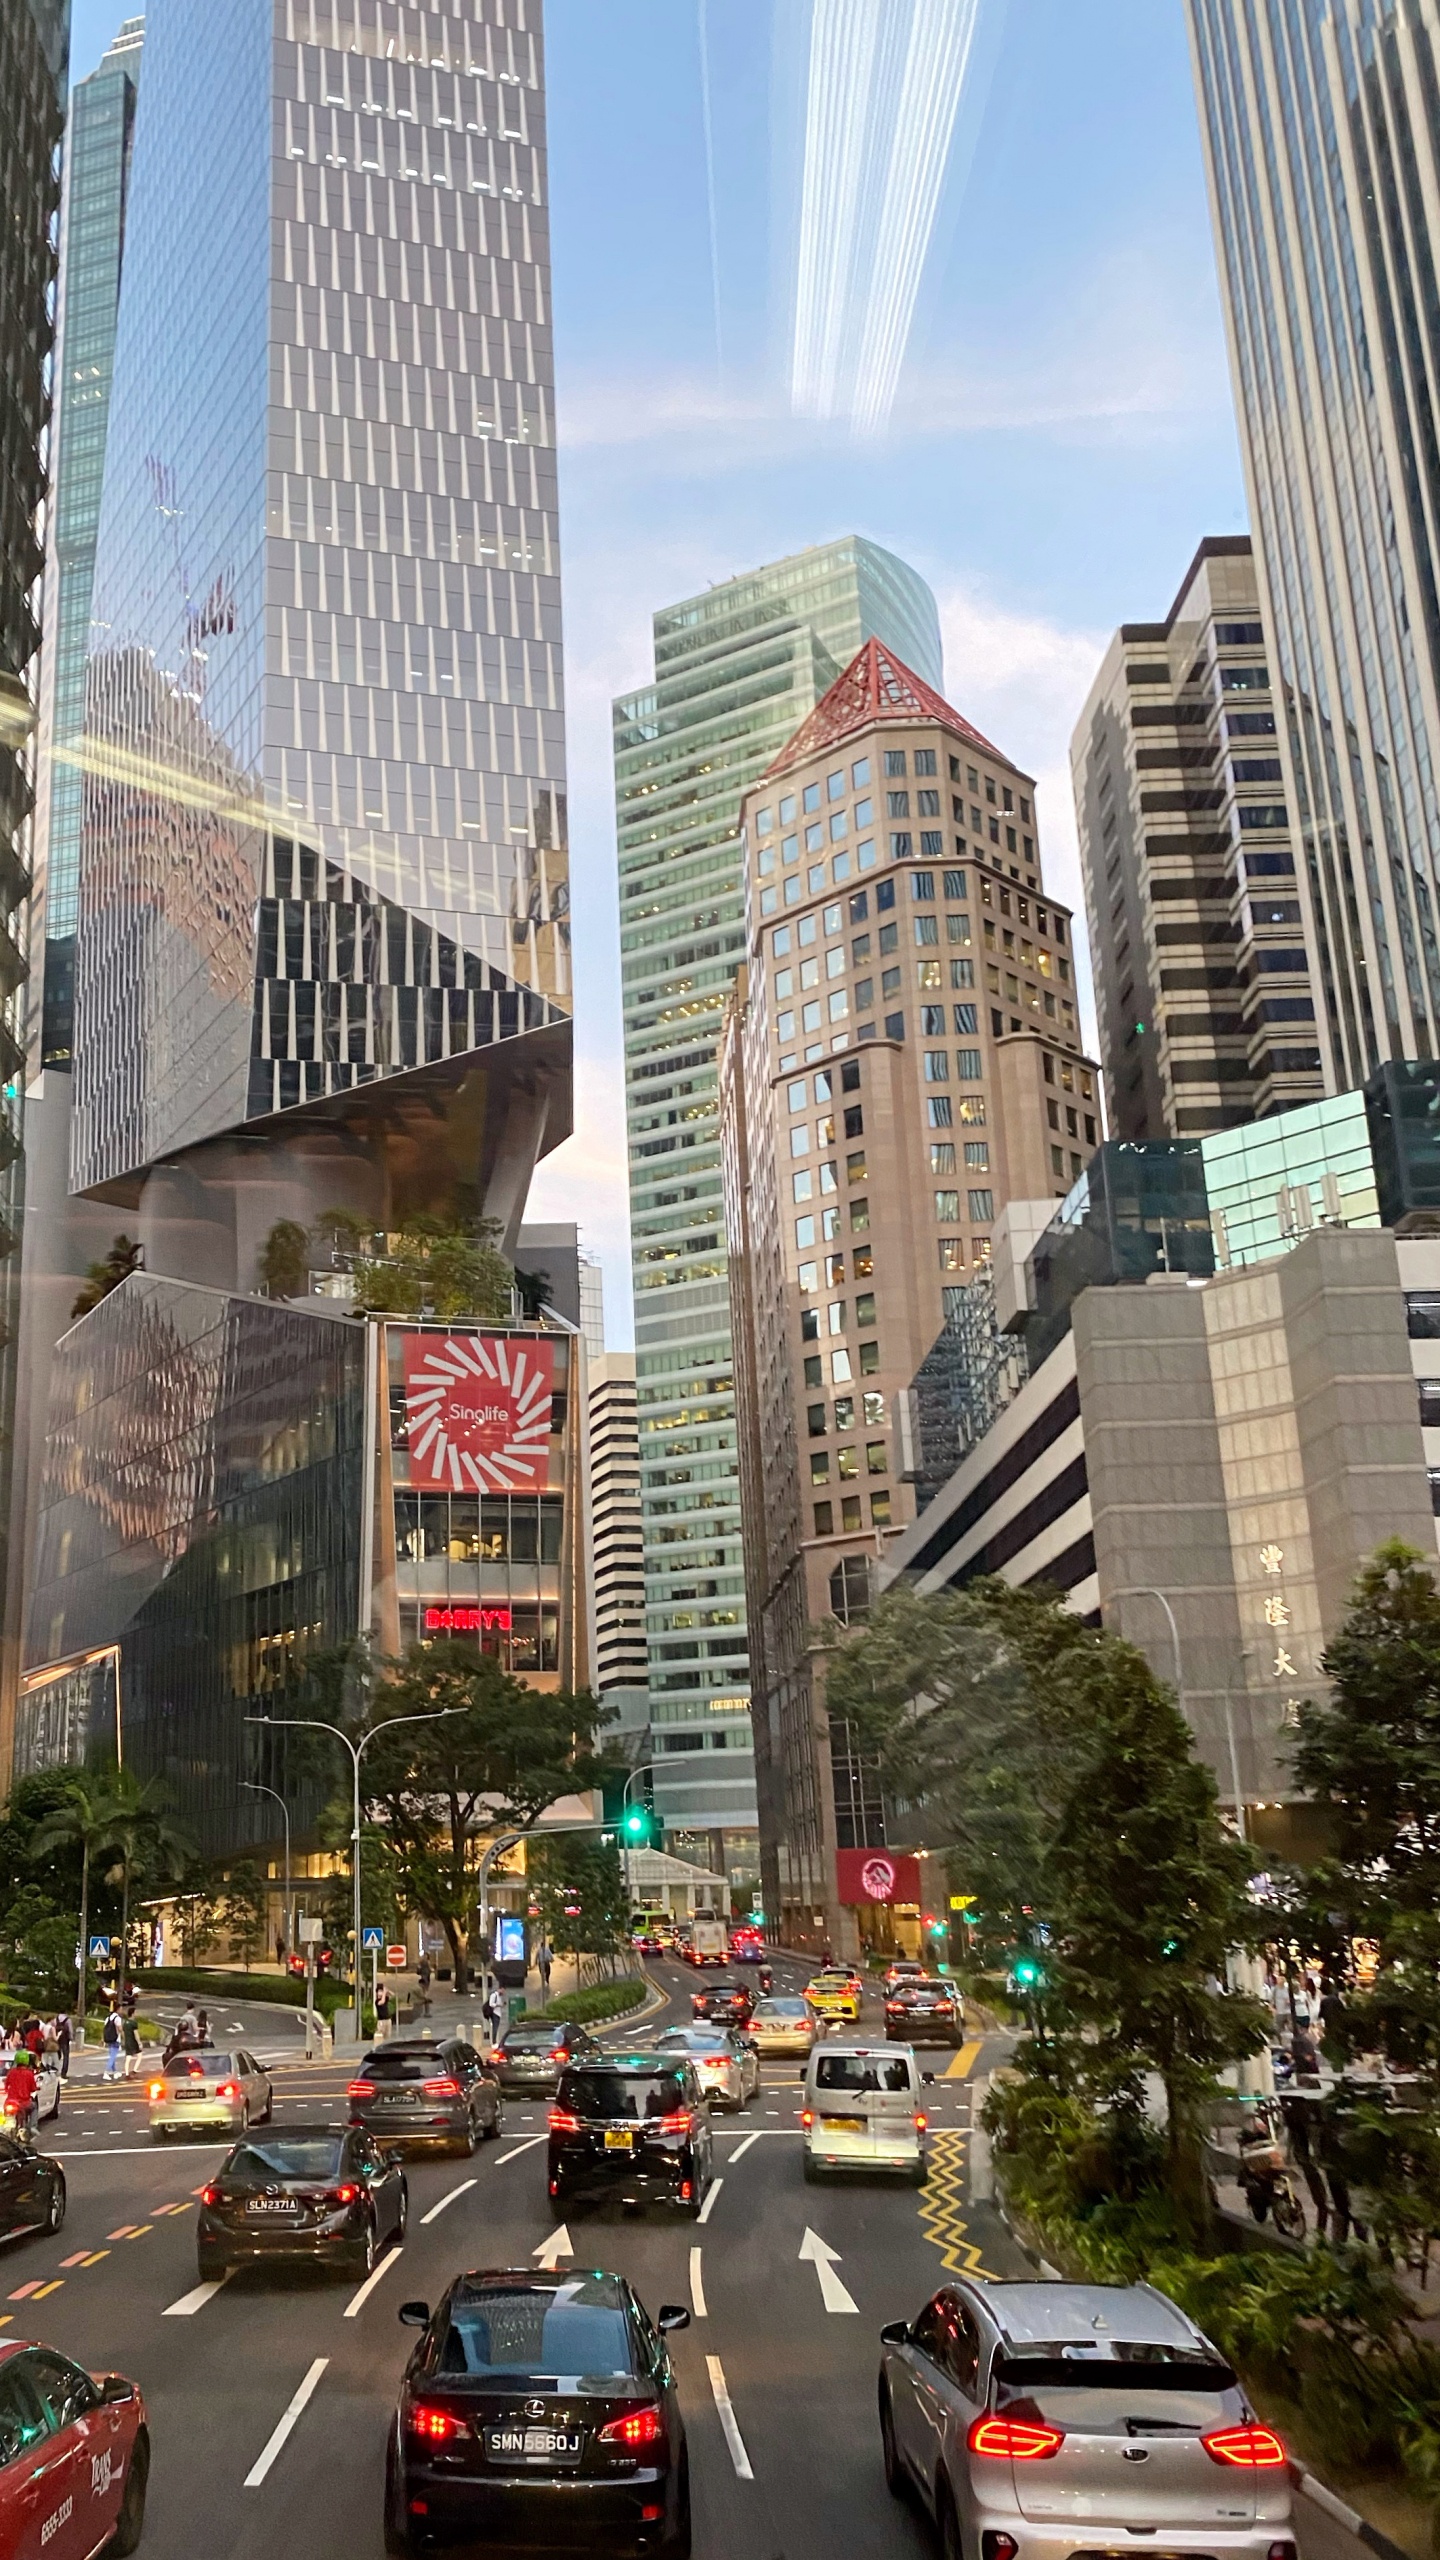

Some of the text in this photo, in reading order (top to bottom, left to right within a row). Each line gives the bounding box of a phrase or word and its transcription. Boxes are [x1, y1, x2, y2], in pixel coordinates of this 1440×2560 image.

[449, 1403, 508, 1425] Singlife
[425, 1609, 511, 1630] BARRY'S
[249, 2200, 296, 2210] SLN2371A
[491, 2433, 579, 2451] SMN6660J
